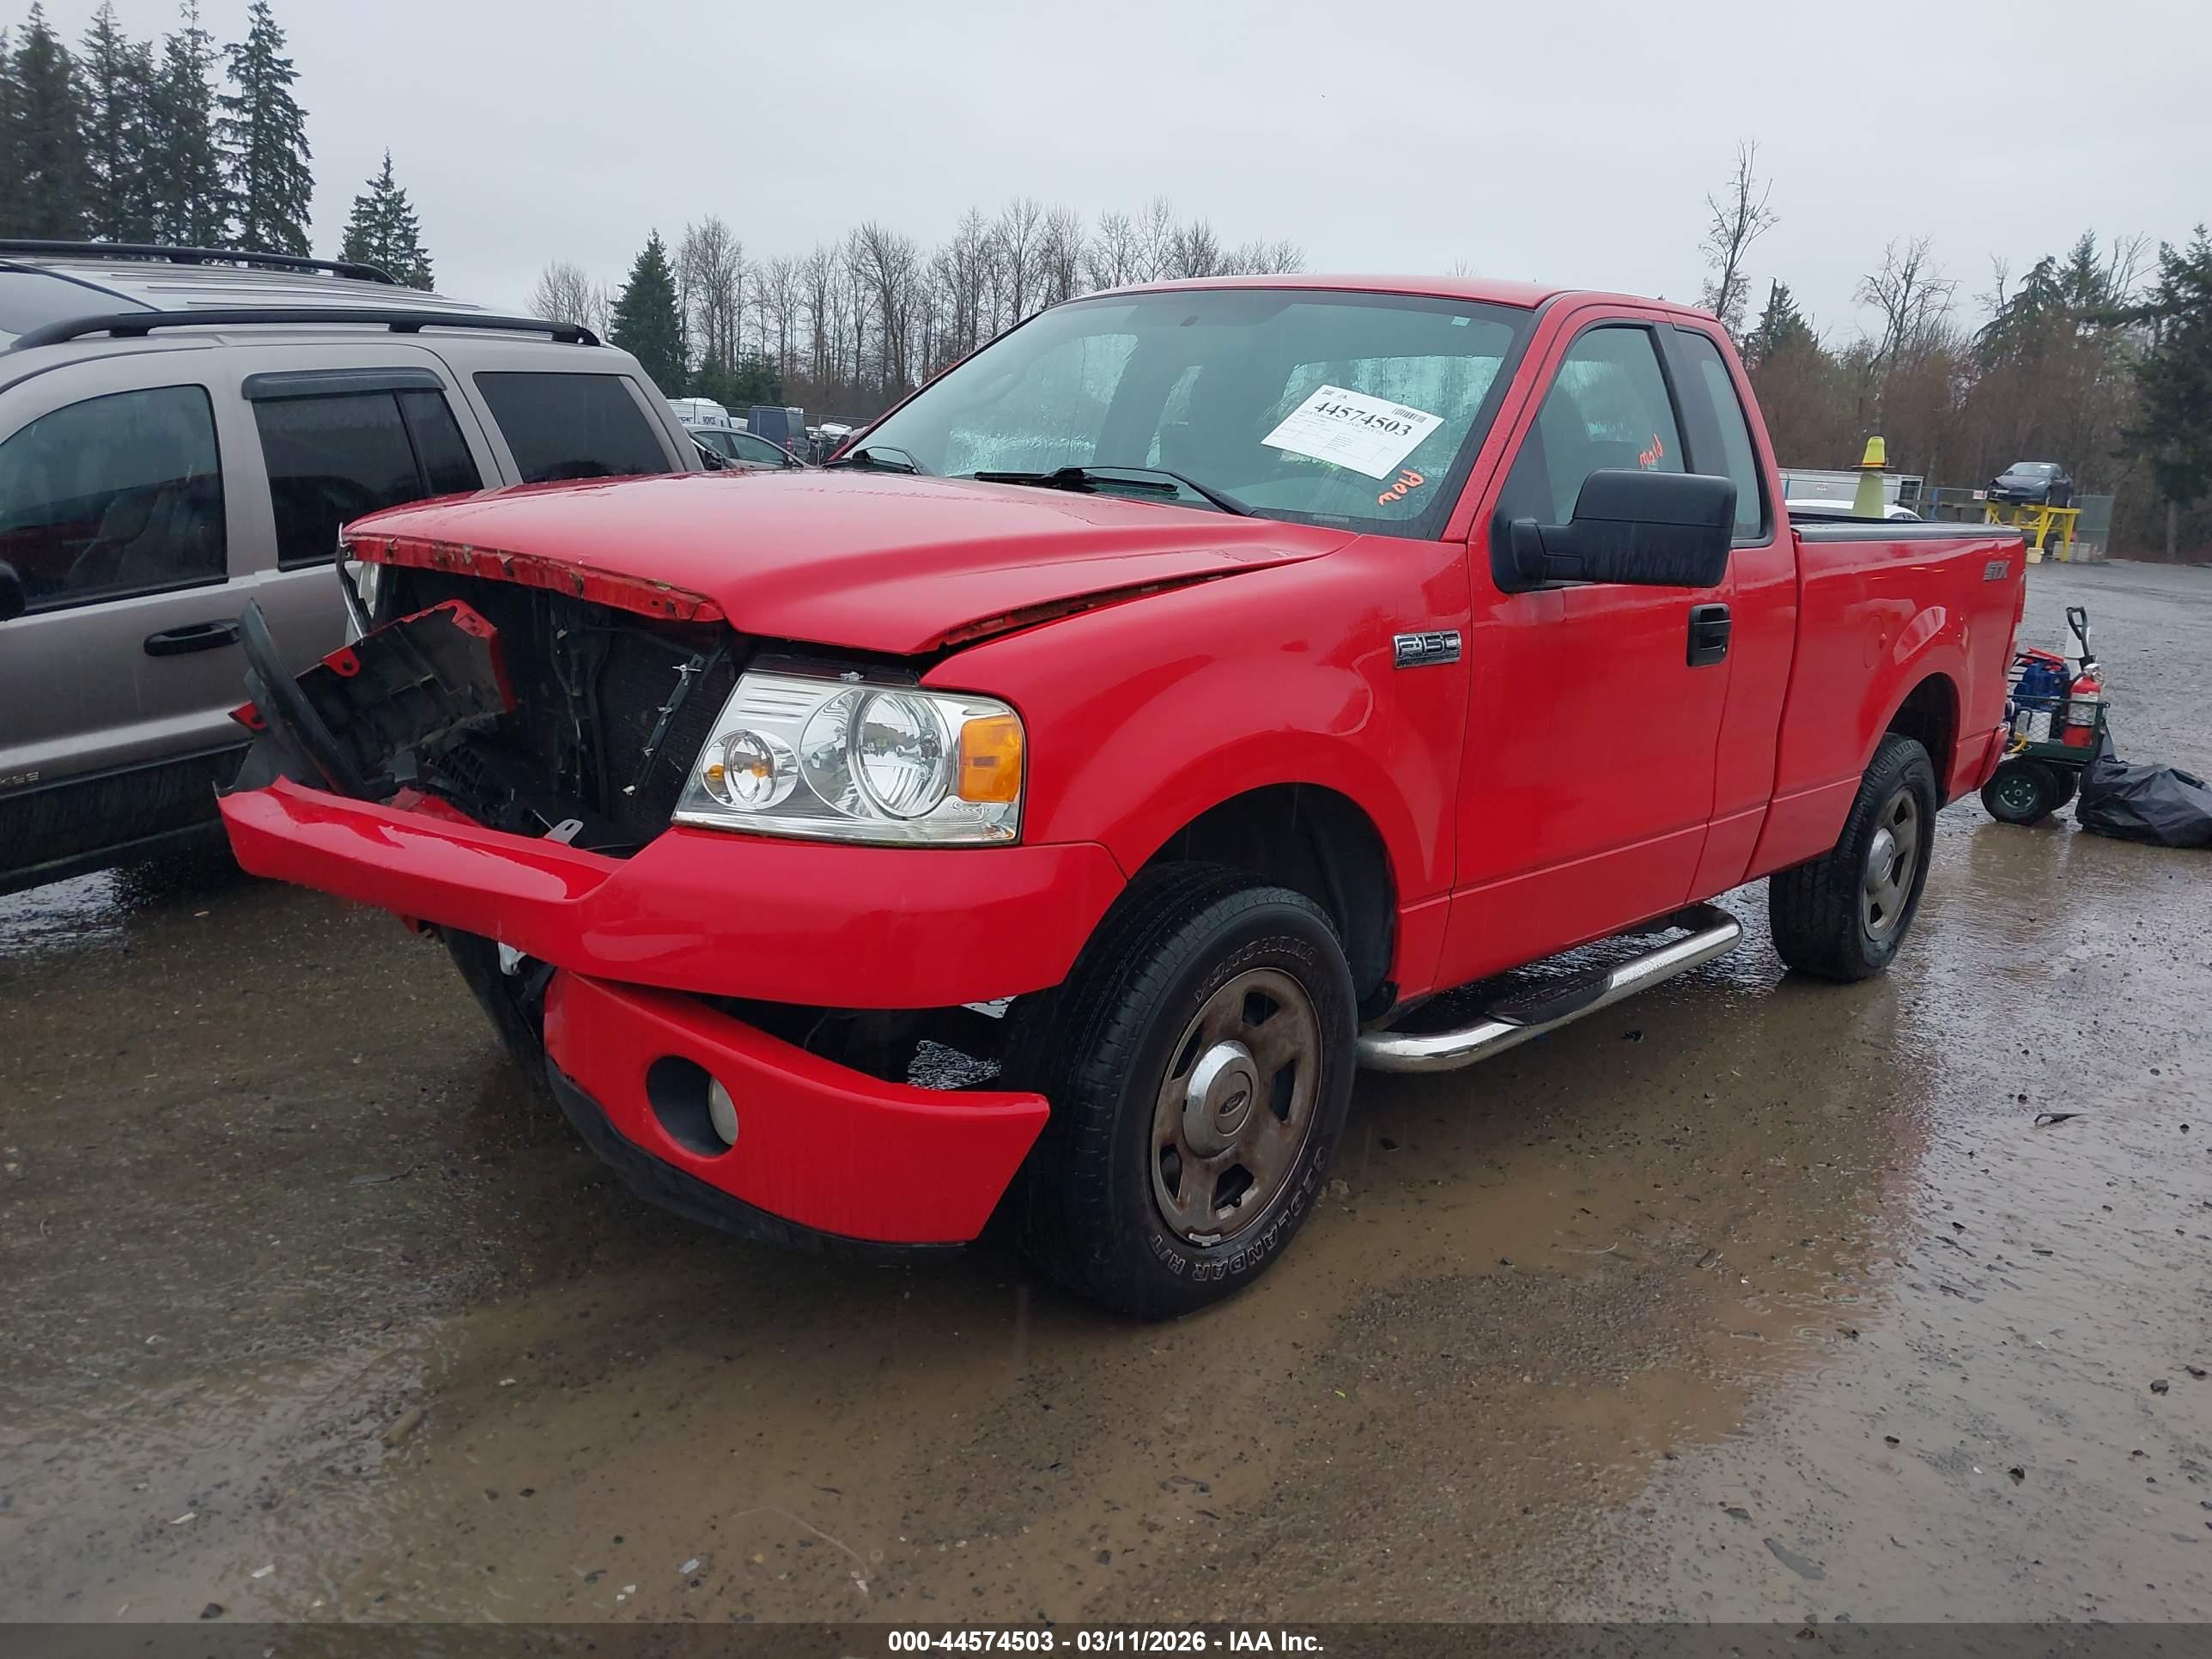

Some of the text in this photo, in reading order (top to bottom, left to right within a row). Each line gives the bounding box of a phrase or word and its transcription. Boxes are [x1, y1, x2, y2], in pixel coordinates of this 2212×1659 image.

[1314, 401, 1413, 437] 44574503
[1148, 1146, 1327, 1282] GEOLANDAR H/T
